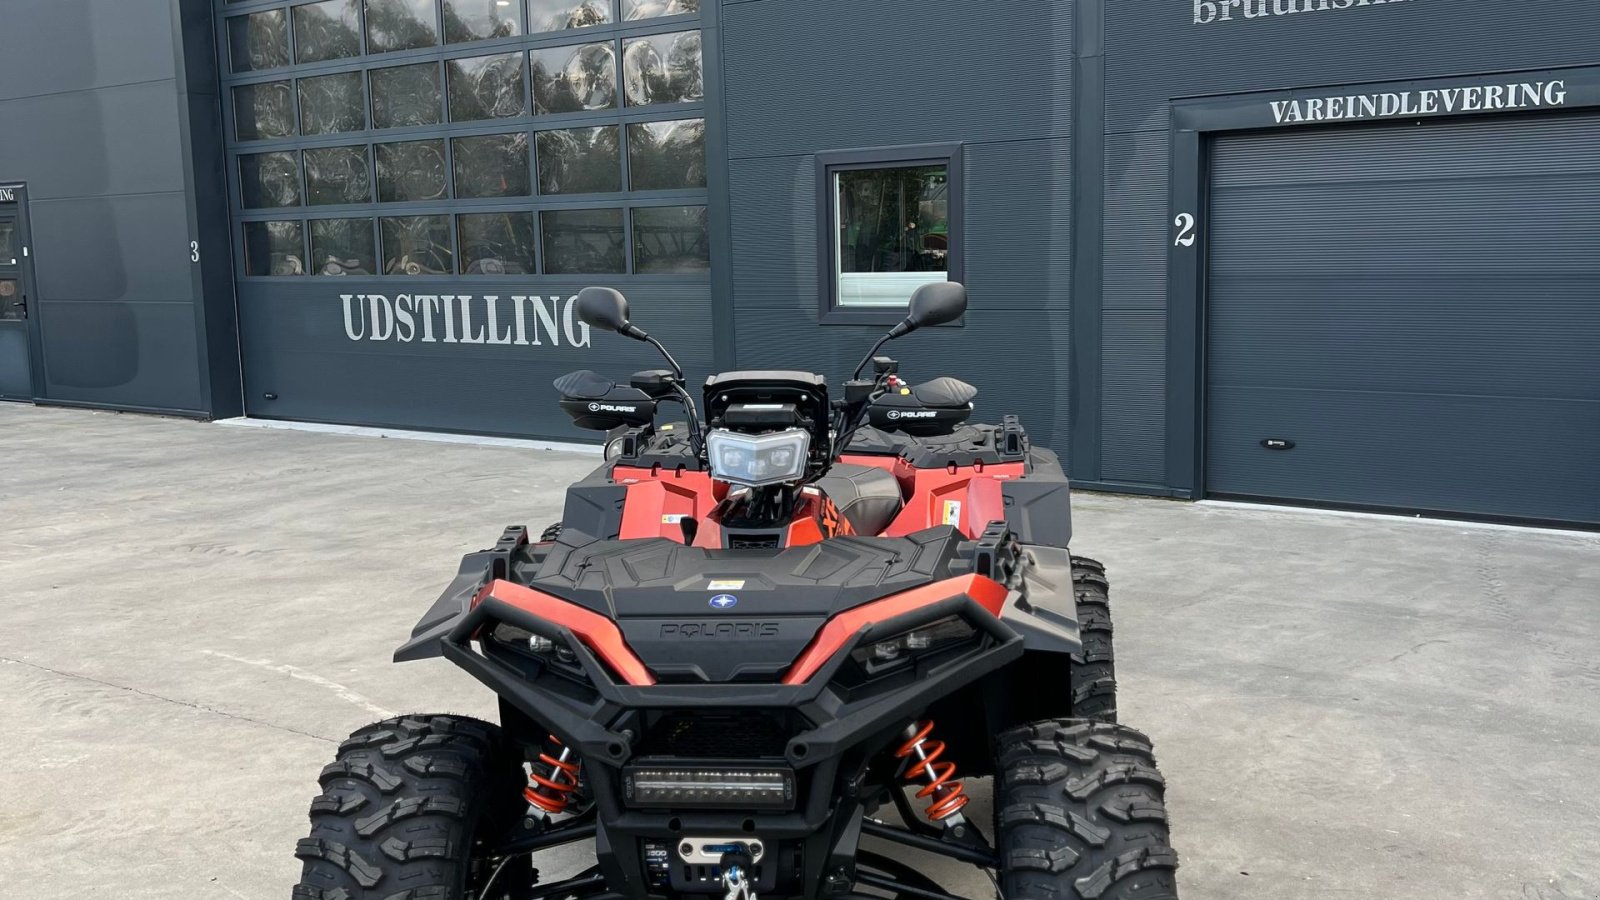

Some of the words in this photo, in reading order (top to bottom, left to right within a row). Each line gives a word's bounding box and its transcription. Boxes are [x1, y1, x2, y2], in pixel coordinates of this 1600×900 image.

[1269, 80, 1567, 123] VAREINDLEVERING
[1174, 212, 1195, 247] 2
[190, 240, 200, 262] 3
[339, 293, 591, 348] UDSTILLING
[600, 404, 637, 413] POLARIS
[660, 623, 779, 638] POLARIS
